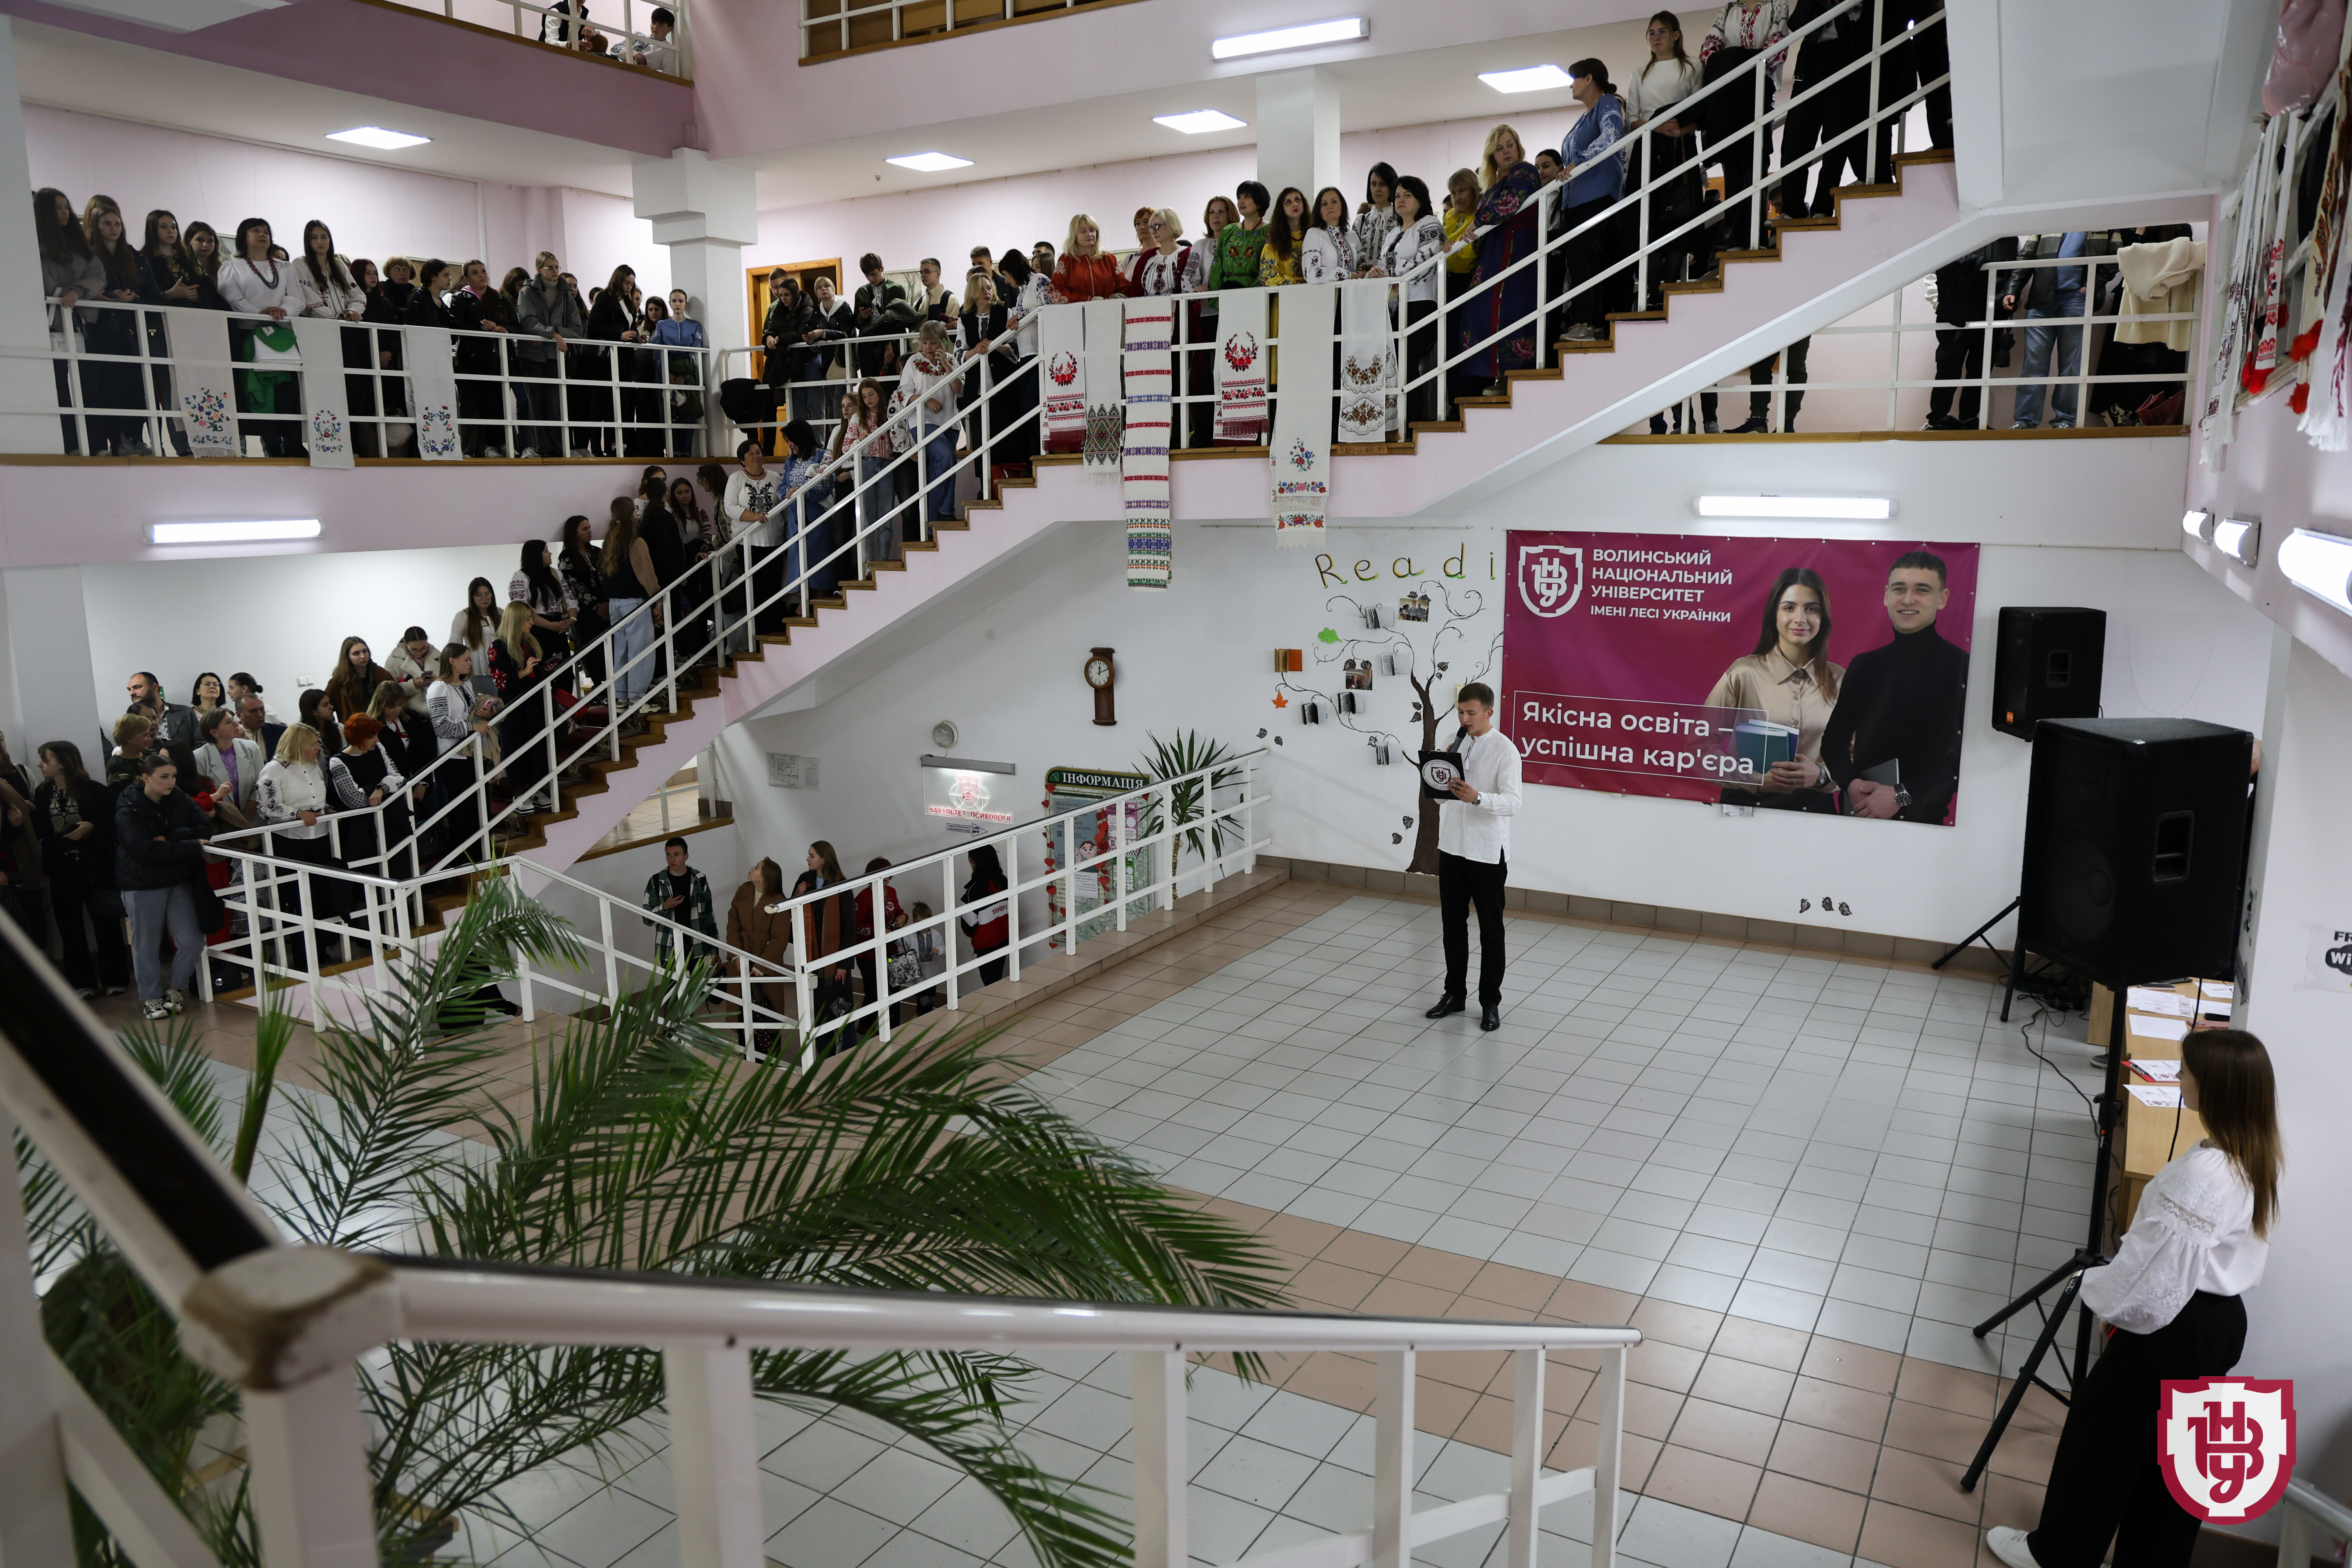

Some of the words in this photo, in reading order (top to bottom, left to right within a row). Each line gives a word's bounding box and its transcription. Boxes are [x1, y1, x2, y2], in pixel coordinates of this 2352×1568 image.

[1593, 549, 1711, 565] ВОЛИНСЬКИЙ
[1592, 567, 1733, 585] НАЦІОНАЛЬНИЙ
[1591, 585, 1705, 602] УНІВЕРСИТЕТ
[1591, 605, 1626, 617] ІМЕНІ
[1629, 607, 1659, 619] ЛЕСІ
[1663, 609, 1731, 622] УКРАЇНКИ
[1523, 701, 1612, 729] Якісна
[1621, 711, 1710, 737] освіта
[1521, 736, 1634, 763] успішна
[1643, 747, 1754, 776] кар'єра
[1062, 772, 1144, 790] ІНФОРМАЦІЯ
[928, 807, 966, 817] ФАКУЛЬТЕТ
[971, 811, 1011, 822] ПСИХОЛОГІЇ
